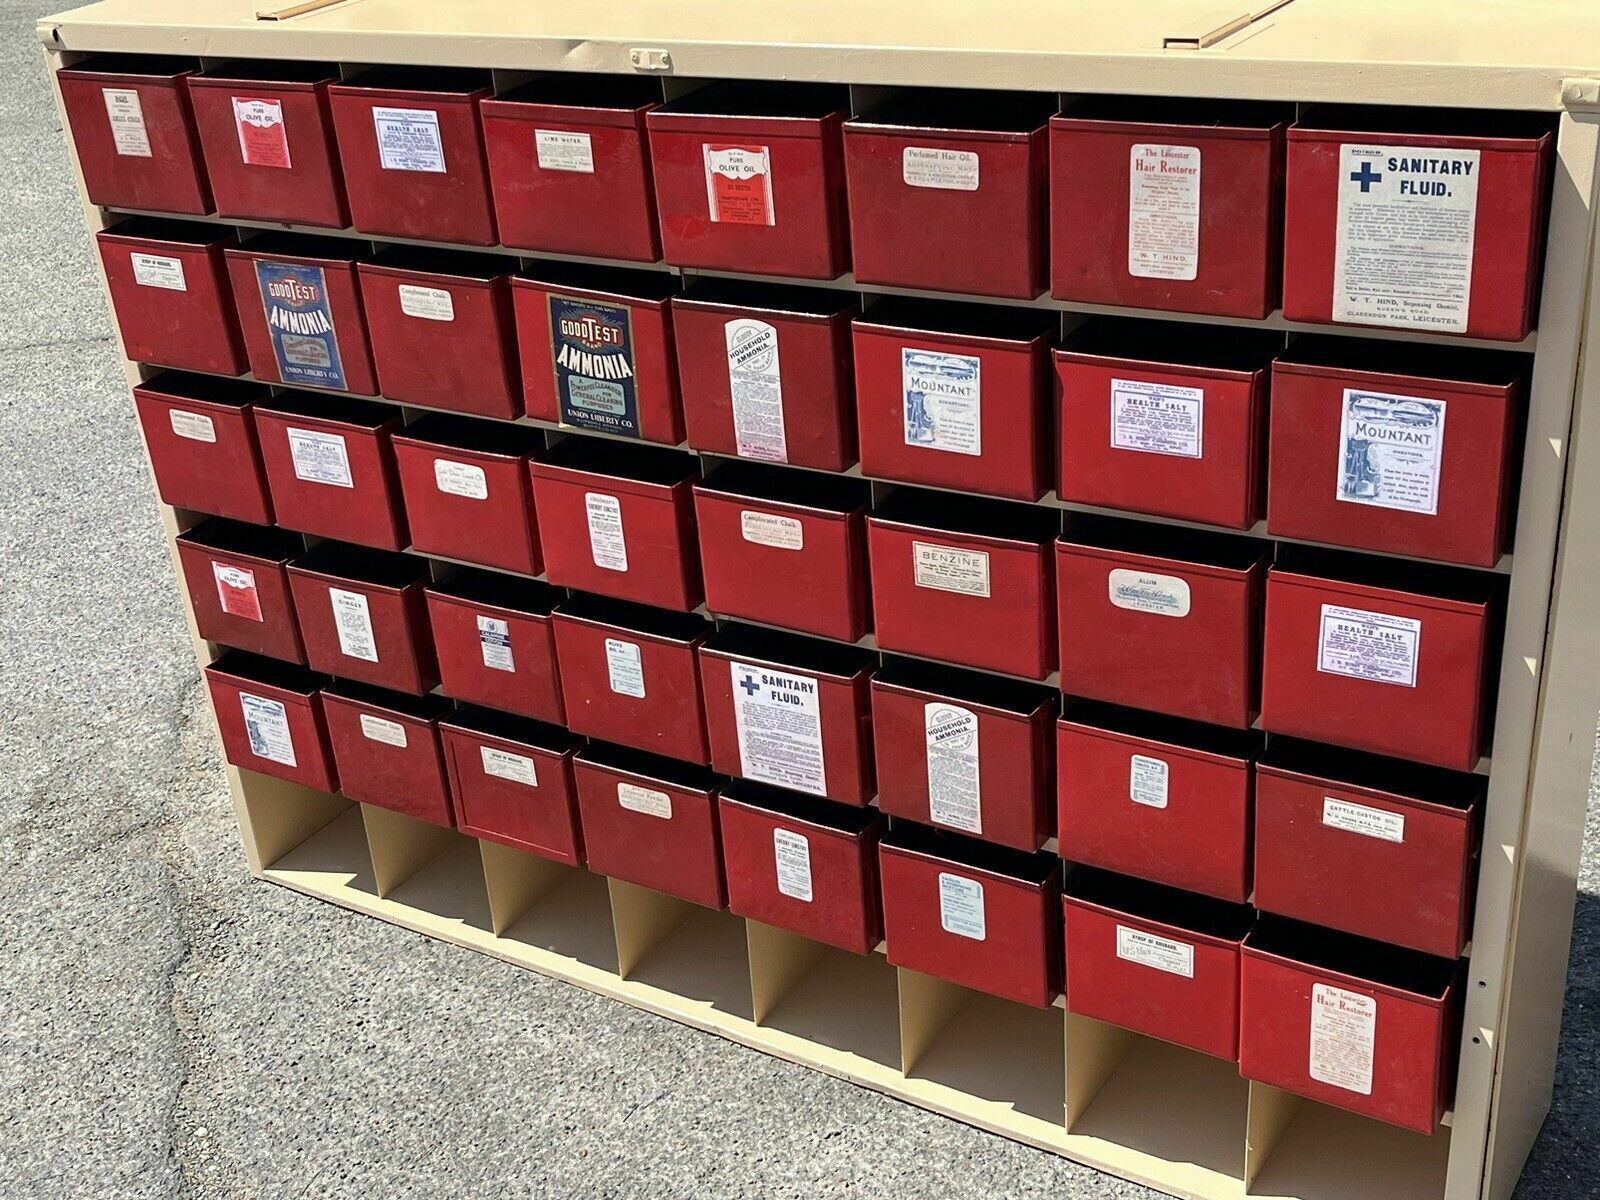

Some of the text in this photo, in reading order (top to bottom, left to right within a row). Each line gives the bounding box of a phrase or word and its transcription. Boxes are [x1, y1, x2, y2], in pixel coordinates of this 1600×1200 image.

[942, 152, 957, 160] Hair
[1145, 149, 1190, 160] The Leicester
[719, 164, 739, 172] OLIVE
[1135, 158, 1197, 176] Hair Restorer
[1387, 157, 1475, 176] SANITARY
[1400, 180, 1452, 197] FLUID.
[270, 304, 332, 336] AMMONIA
[729, 332, 771, 359] HOUSEHOLD
[556, 343, 633, 379] AMMONIA
[285, 366, 303, 375] UNION
[304, 368, 327, 379] LIBERTY
[1127, 398, 1188, 412] HEALTH SALT
[567, 408, 589, 419] UNION
[590, 414, 620, 426] LIBERTY
[621, 419, 634, 429] CO.
[923, 551, 979, 568] BENZINE
[1337, 624, 1404, 641] HEALTH SALT
[761, 674, 814, 695] SANITARY
[771, 691, 804, 706] FLUID.
[927, 717, 971, 737] HOUSEHOLD
[1329, 805, 1355, 816] CATTLE
[1356, 811, 1382, 822] CASTOR
[1316, 994, 1374, 1019] Hair Restorer
